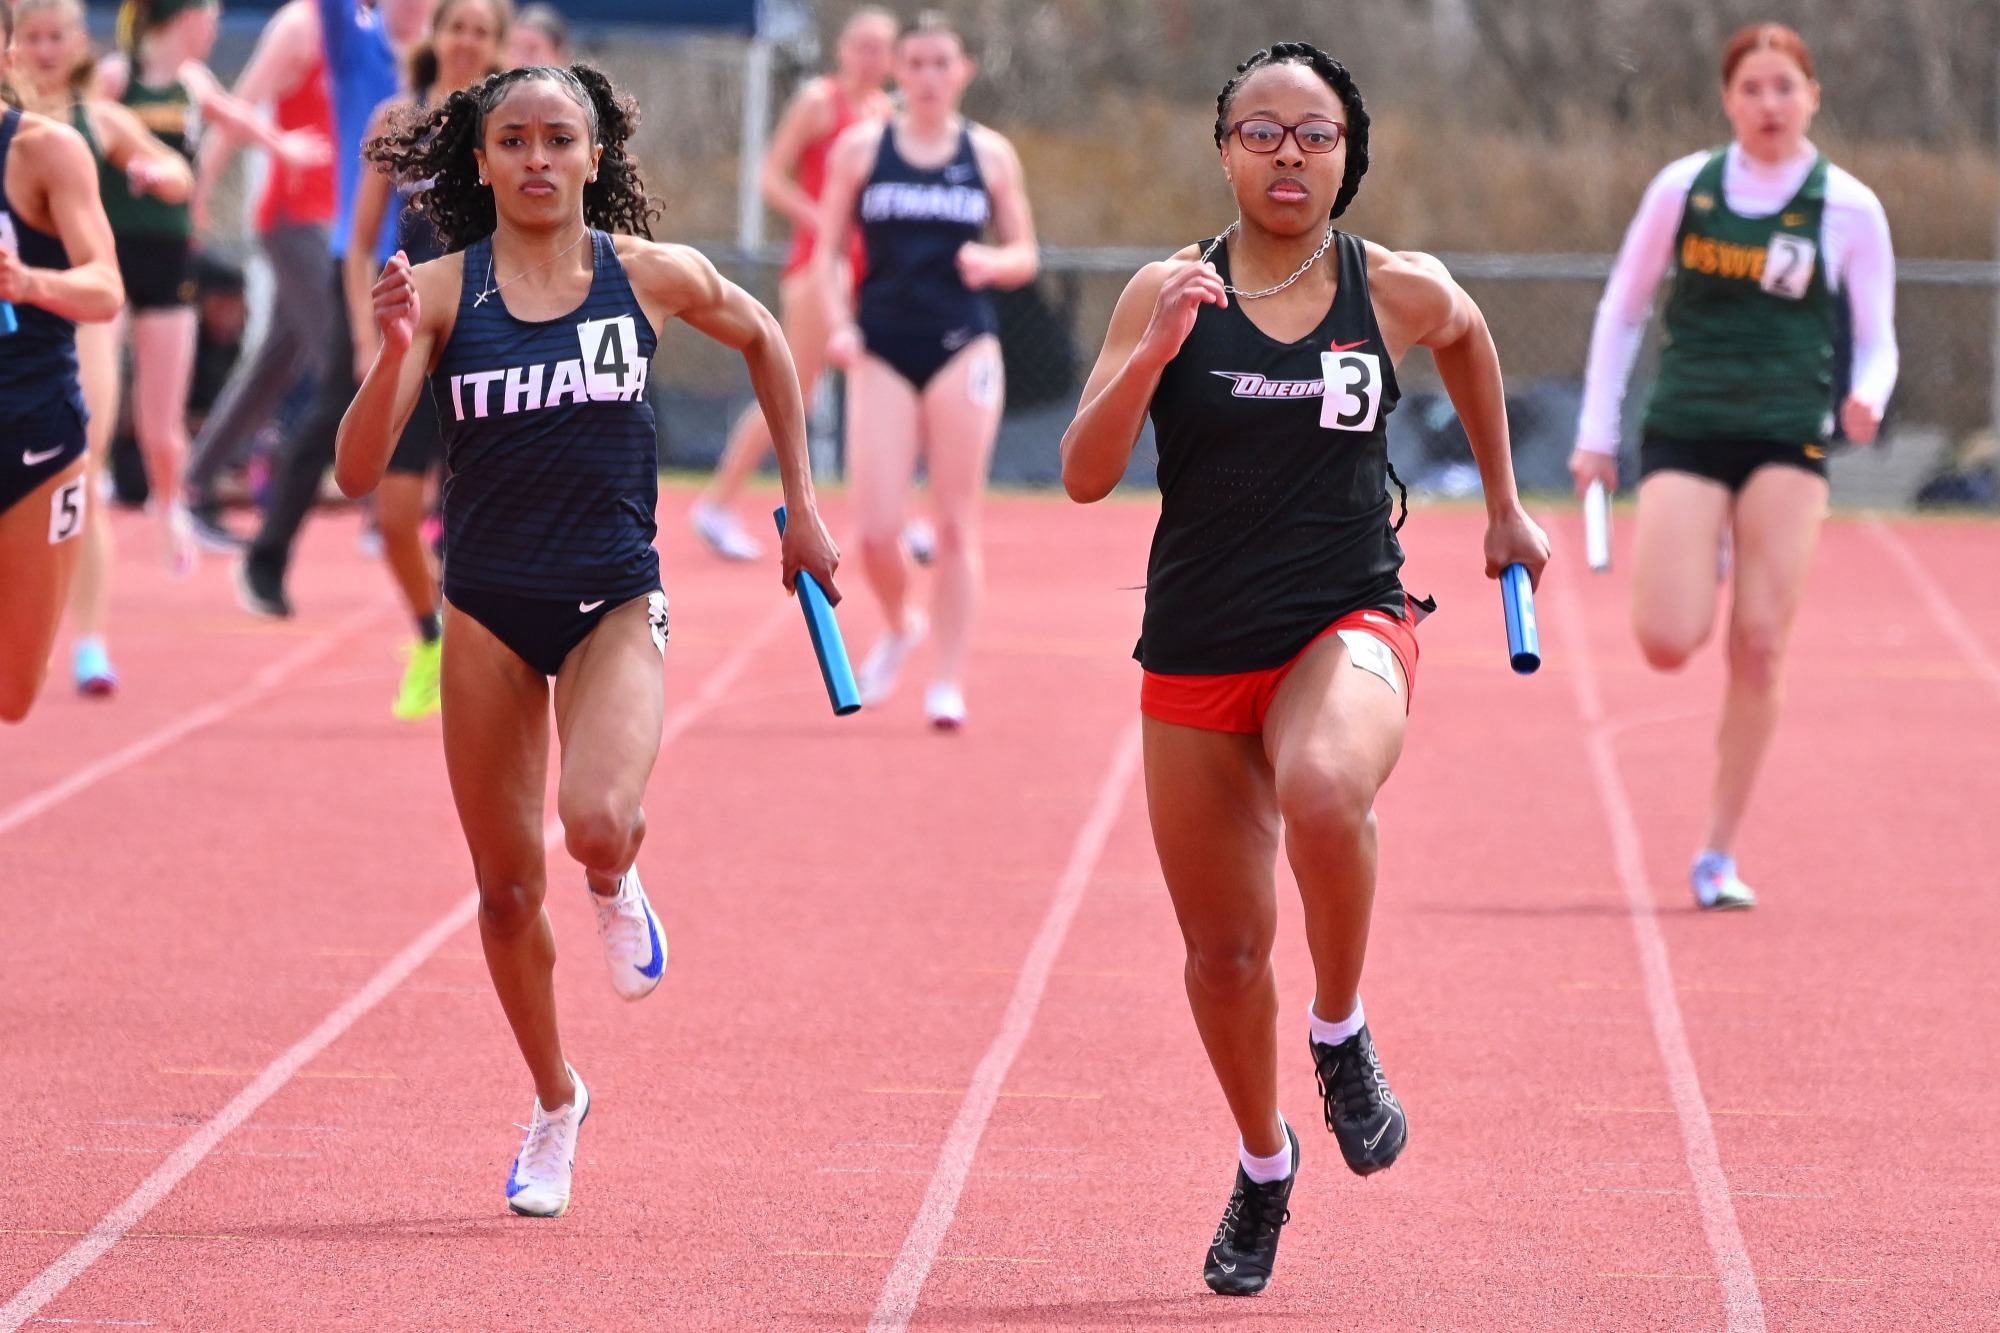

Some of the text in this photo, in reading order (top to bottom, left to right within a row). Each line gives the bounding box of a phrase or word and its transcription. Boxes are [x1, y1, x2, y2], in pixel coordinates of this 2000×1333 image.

[1681, 233, 1767, 281] OSWE
[1774, 242, 1799, 293] 2
[593, 322, 630, 388] 4
[451, 356, 648, 421] ITHAA
[1336, 356, 1371, 427] 3
[58, 485, 79, 539] 5
